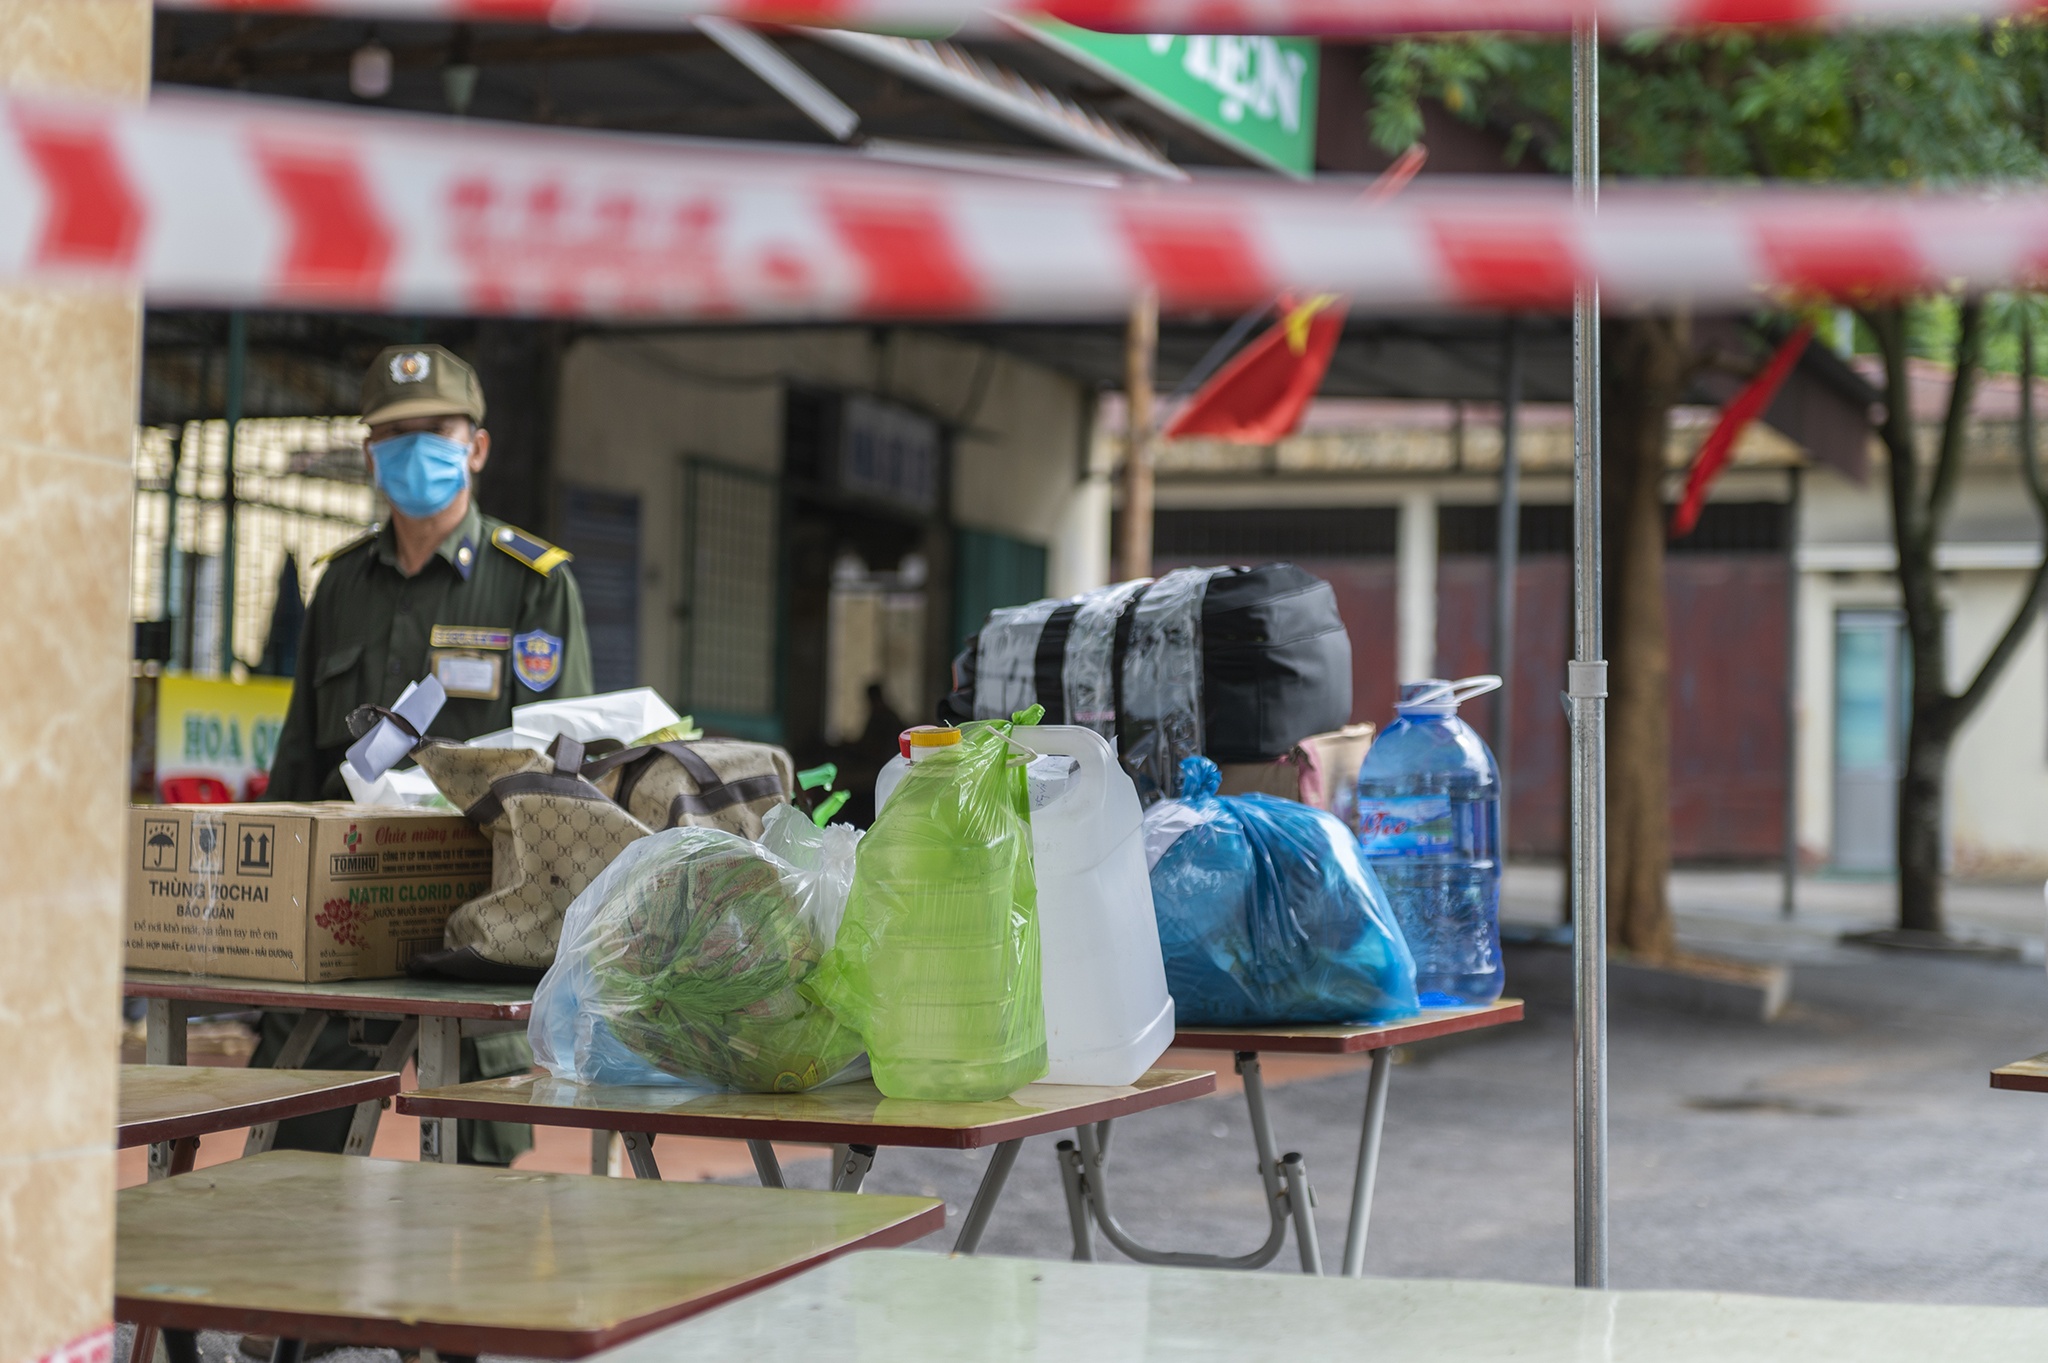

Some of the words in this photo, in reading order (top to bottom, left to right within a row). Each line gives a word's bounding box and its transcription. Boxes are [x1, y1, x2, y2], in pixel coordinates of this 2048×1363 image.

[184, 716, 243, 763] HOA
[149, 876, 206, 900] THÙNG
[349, 886, 394, 904] NATRI
[398, 883, 452, 902] CLORID
